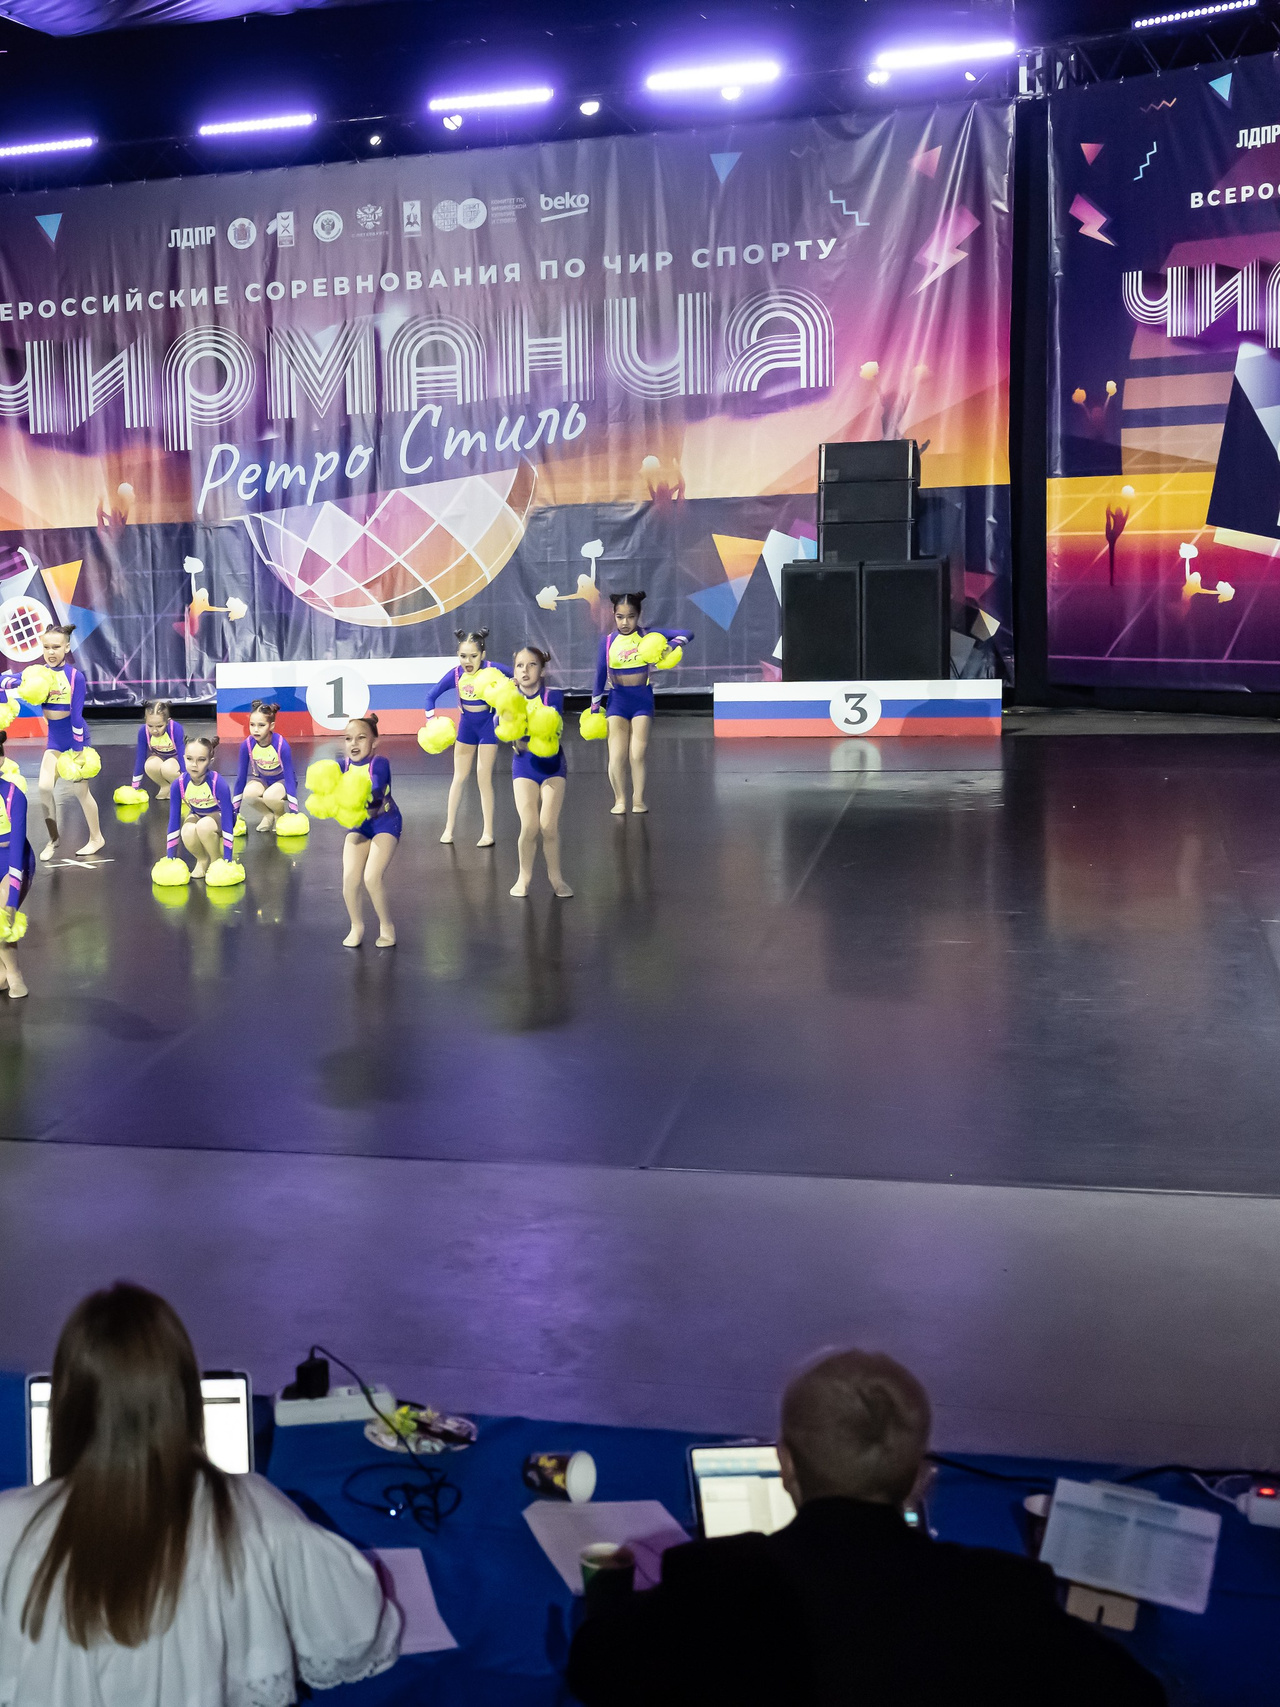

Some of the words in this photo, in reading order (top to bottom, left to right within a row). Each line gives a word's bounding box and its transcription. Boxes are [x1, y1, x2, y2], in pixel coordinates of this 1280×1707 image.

[1236, 124, 1280, 149] ЛДПР
[539, 192, 590, 211] beko
[1190, 183, 1280, 208] ВСЕРО
[167, 226, 217, 250] ЛДПР
[244, 262, 522, 301] СОРЕВНОВАНИЯ
[540, 257, 587, 282] ПО
[603, 249, 675, 275] ЧИР
[692, 237, 838, 269] СПОРТУ
[196, 442, 375, 515] Ретро
[399, 402, 588, 476] Стиль
[326, 677, 350, 718] 1
[843, 693, 868, 725] 3
